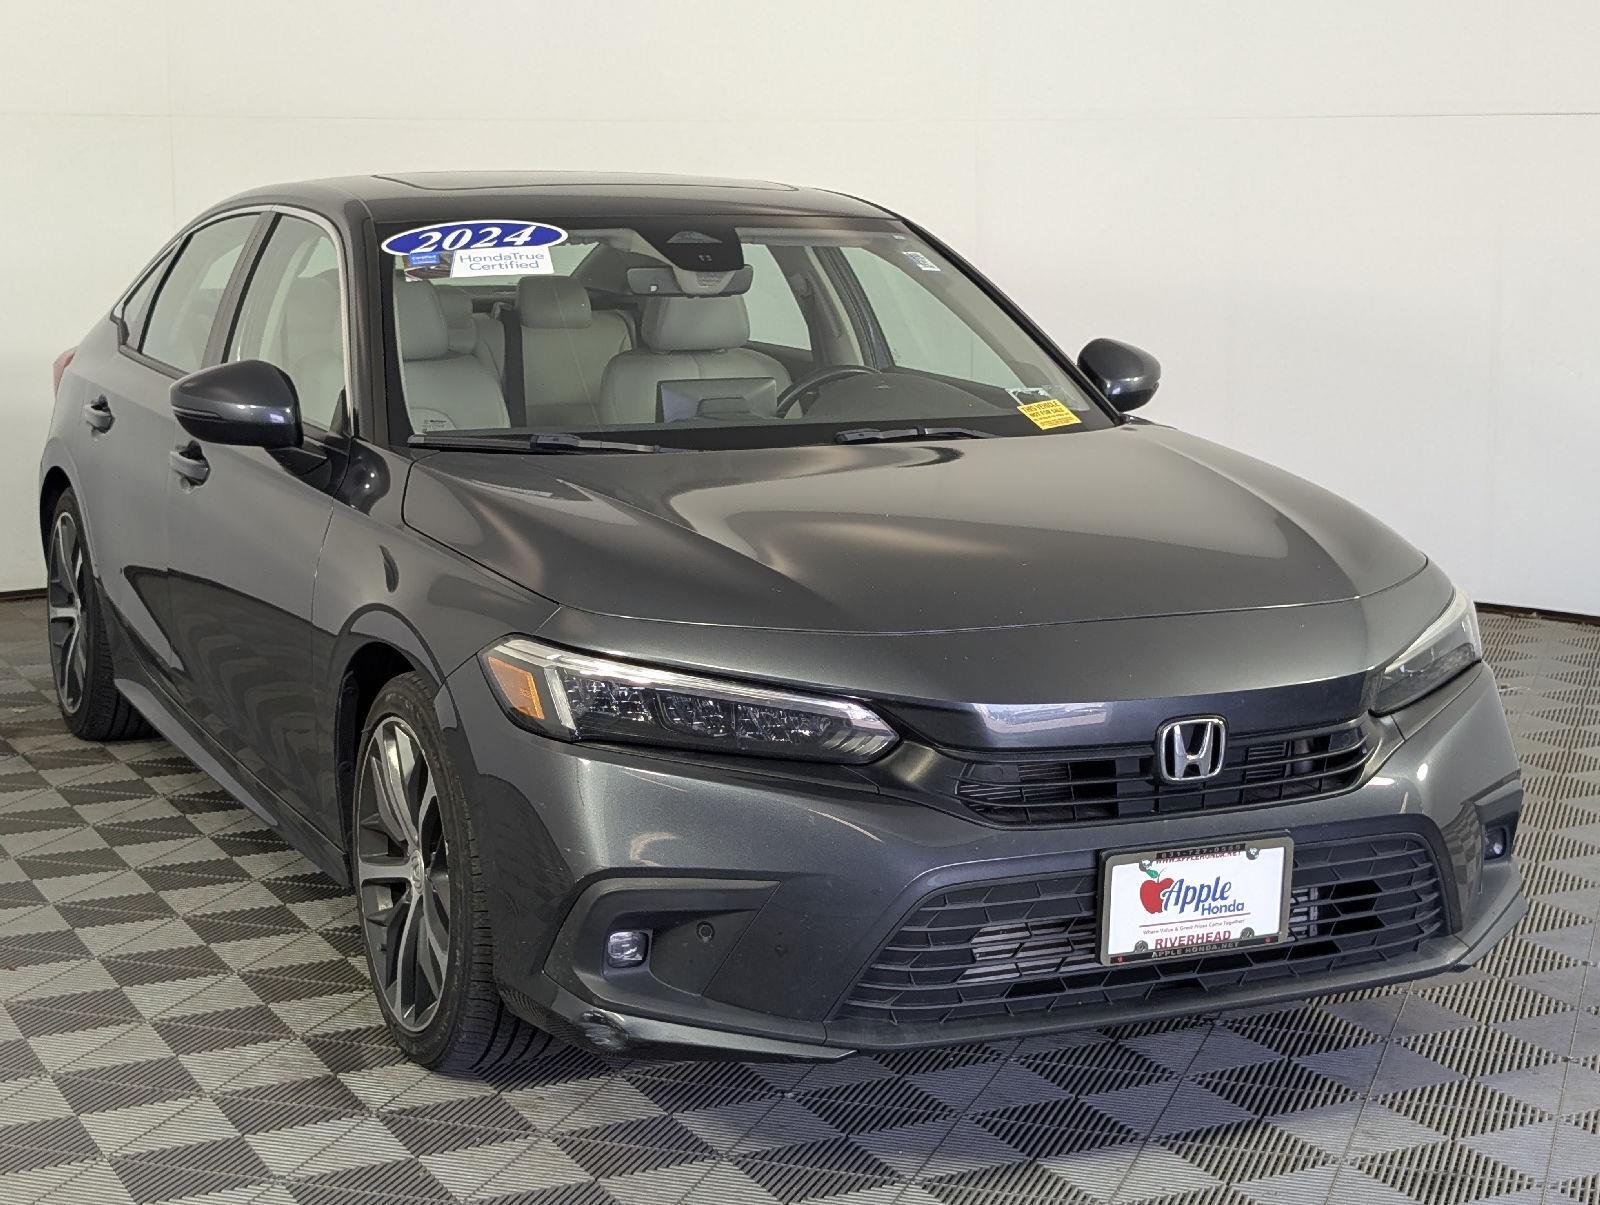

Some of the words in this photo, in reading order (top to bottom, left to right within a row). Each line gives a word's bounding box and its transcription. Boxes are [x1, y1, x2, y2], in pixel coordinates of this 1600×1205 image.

[409, 224, 537, 254] 2024
[459, 251, 545, 264] HondaTrue
[469, 259, 540, 271] Certified
[1162, 876, 1232, 914] Apple
[1201, 899, 1245, 916] Honda
[1180, 924, 1194, 932] Great
[1154, 930, 1232, 950] RIVERHEAD
[1151, 947, 1182, 958] APPLE
